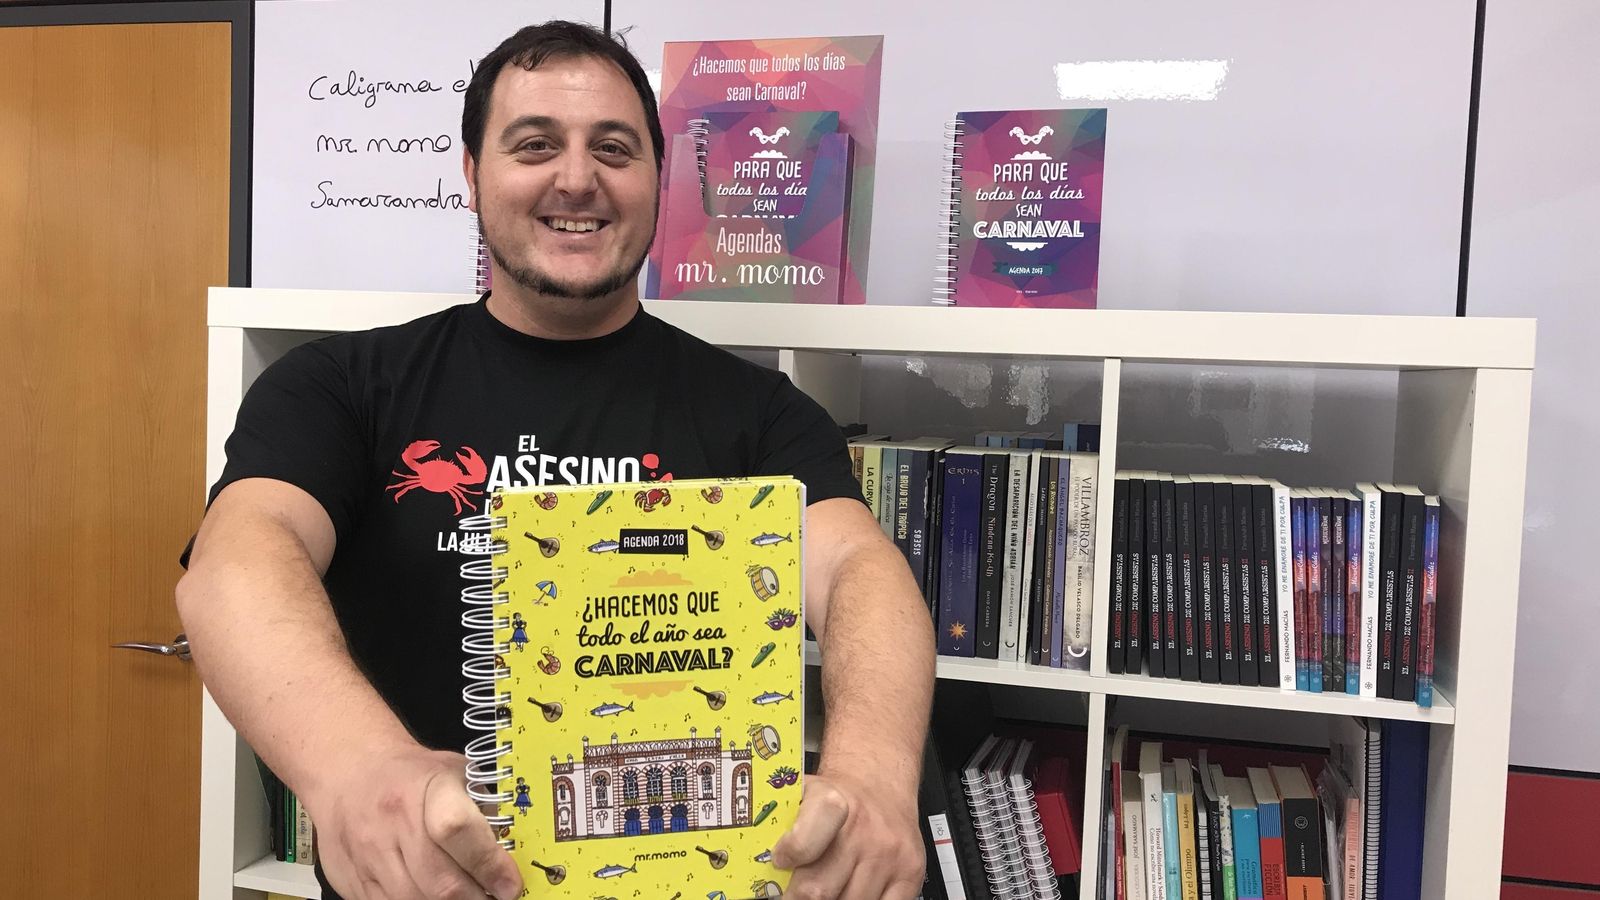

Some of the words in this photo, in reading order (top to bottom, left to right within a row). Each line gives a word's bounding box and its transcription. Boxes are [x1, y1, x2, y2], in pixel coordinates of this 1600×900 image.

[692, 56, 745, 77] ¿Hacemos
[749, 58, 768, 76] que
[771, 55, 801, 73] todos
[803, 54, 819, 72] los
[823, 52, 846, 71] días
[726, 86, 752, 102] sean
[754, 81, 807, 101] Carnaval?
[733, 161, 770, 179] PARA
[776, 160, 802, 181] QUE
[993, 163, 1033, 183] PARA
[1040, 162, 1068, 184] QUE
[716, 183, 754, 196] todos
[758, 182, 779, 196] los
[784, 181, 808, 196] día
[975, 187, 1016, 201] todos
[1021, 186, 1044, 200] los
[1049, 184, 1085, 200] días
[753, 199, 777, 212] SEAN
[1015, 203, 1042, 218] SEAN
[972, 220, 1085, 239] CARNAVAL
[716, 227, 782, 257] Agendas
[675, 261, 727, 283] mr.
[736, 263, 826, 286] momo
[1008, 267, 1031, 275] AGENDA
[518, 434, 540, 452] EL
[486, 453, 640, 493] ASESINO
[867, 467, 874, 477] LA
[900, 464, 909, 473] EL
[1013, 469, 1021, 477] LA
[899, 475, 909, 496] BRUJO
[986, 476, 998, 511] Dragon
[898, 497, 908, 510] DEL
[1278, 495, 1286, 515] CULPA
[1078, 476, 1092, 556] VILLAMBROZ
[897, 512, 909, 540] TRÓPICO
[1010, 520, 1019, 531] DEL
[1368, 520, 1376, 533] POR
[437, 531, 458, 551] LA
[623, 535, 660, 548] AGENDA
[662, 533, 685, 547] 2018
[1280, 535, 1287, 544] DE
[1368, 541, 1375, 550] DE
[1151, 554, 1159, 603] COMPARSISTAS
[1165, 554, 1174, 602] COMPARSISTAS
[1183, 559, 1192, 608] COMPARSISTAS
[1281, 574, 1288, 584] ME
[1367, 580, 1375, 589] ME
[1203, 562, 1211, 611] COMPARSISTAS
[1222, 563, 1231, 612] COMPARSISTAS
[1261, 566, 1270, 615] COMPARSISTAS
[1281, 585, 1288, 593] YO
[1367, 590, 1374, 599] YO
[1404, 574, 1414, 626] COMPARSISTAS
[582, 592, 679, 623] ¿HACEMOS
[687, 590, 720, 617] QUE
[1115, 602, 1122, 611] DE
[1152, 603, 1159, 612] DE
[1167, 602, 1174, 611] DE
[1185, 608, 1192, 618] DE
[1204, 611, 1211, 621] DE
[1224, 613, 1231, 622] DE
[1263, 615, 1270, 625] DE
[1282, 610, 1290, 631] MACÍAS
[576, 622, 626, 647] todo
[630, 620, 650, 644] el
[653, 624, 689, 643] año
[692, 625, 727, 641] sea
[1365, 616, 1373, 638] MACÍAS
[1403, 626, 1411, 636] DE
[1114, 640, 1121, 648] EL
[1152, 641, 1160, 649] EL
[1168, 640, 1175, 649] EL
[1186, 646, 1193, 656] EL
[1283, 632, 1291, 663] FERNANDO
[1205, 650, 1212, 659] EL
[1225, 651, 1232, 660] EL
[1264, 653, 1271, 662] EL
[1366, 638, 1374, 670] FERNANDO
[574, 646, 734, 679] CARNAVAL?
[1402, 666, 1409, 675] EL
[1131, 814, 1139, 845] SARAMAGO
[1184, 848, 1194, 879] Olimpo
